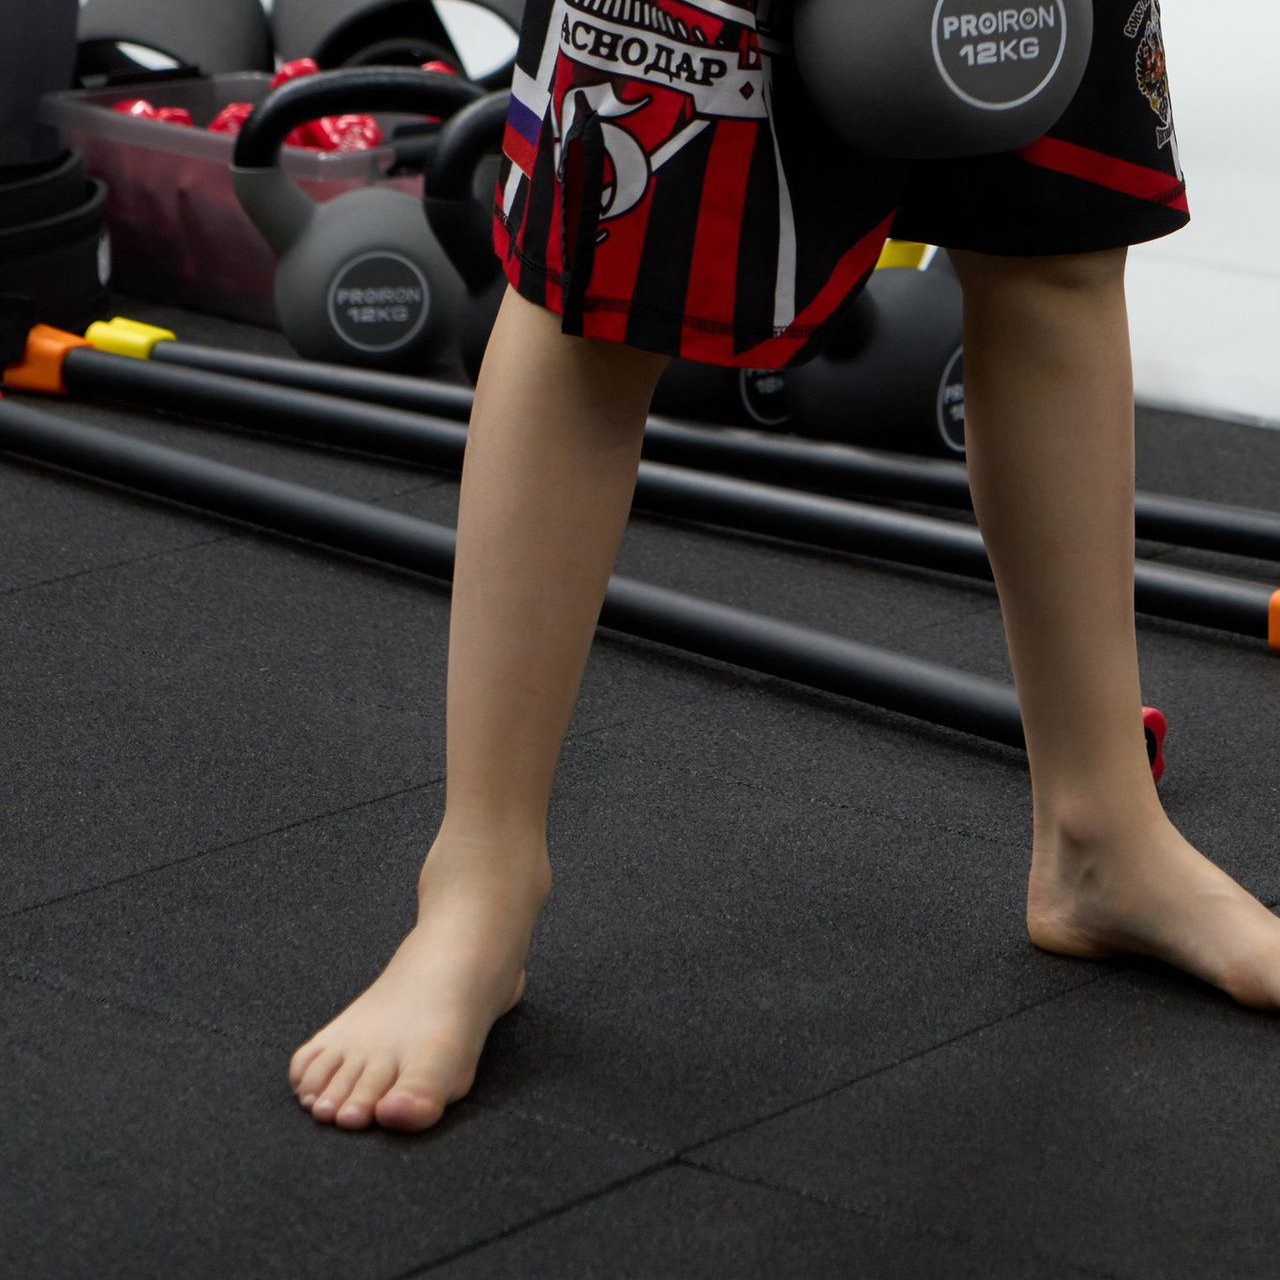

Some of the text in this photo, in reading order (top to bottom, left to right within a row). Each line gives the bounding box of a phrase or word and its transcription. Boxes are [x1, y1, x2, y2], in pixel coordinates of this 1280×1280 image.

[943, 5, 1055, 40] PROIRON
[959, 36, 1040, 67] 12KG
[337, 287, 421, 305] PROIRON
[346, 305, 409, 323] 12KG
